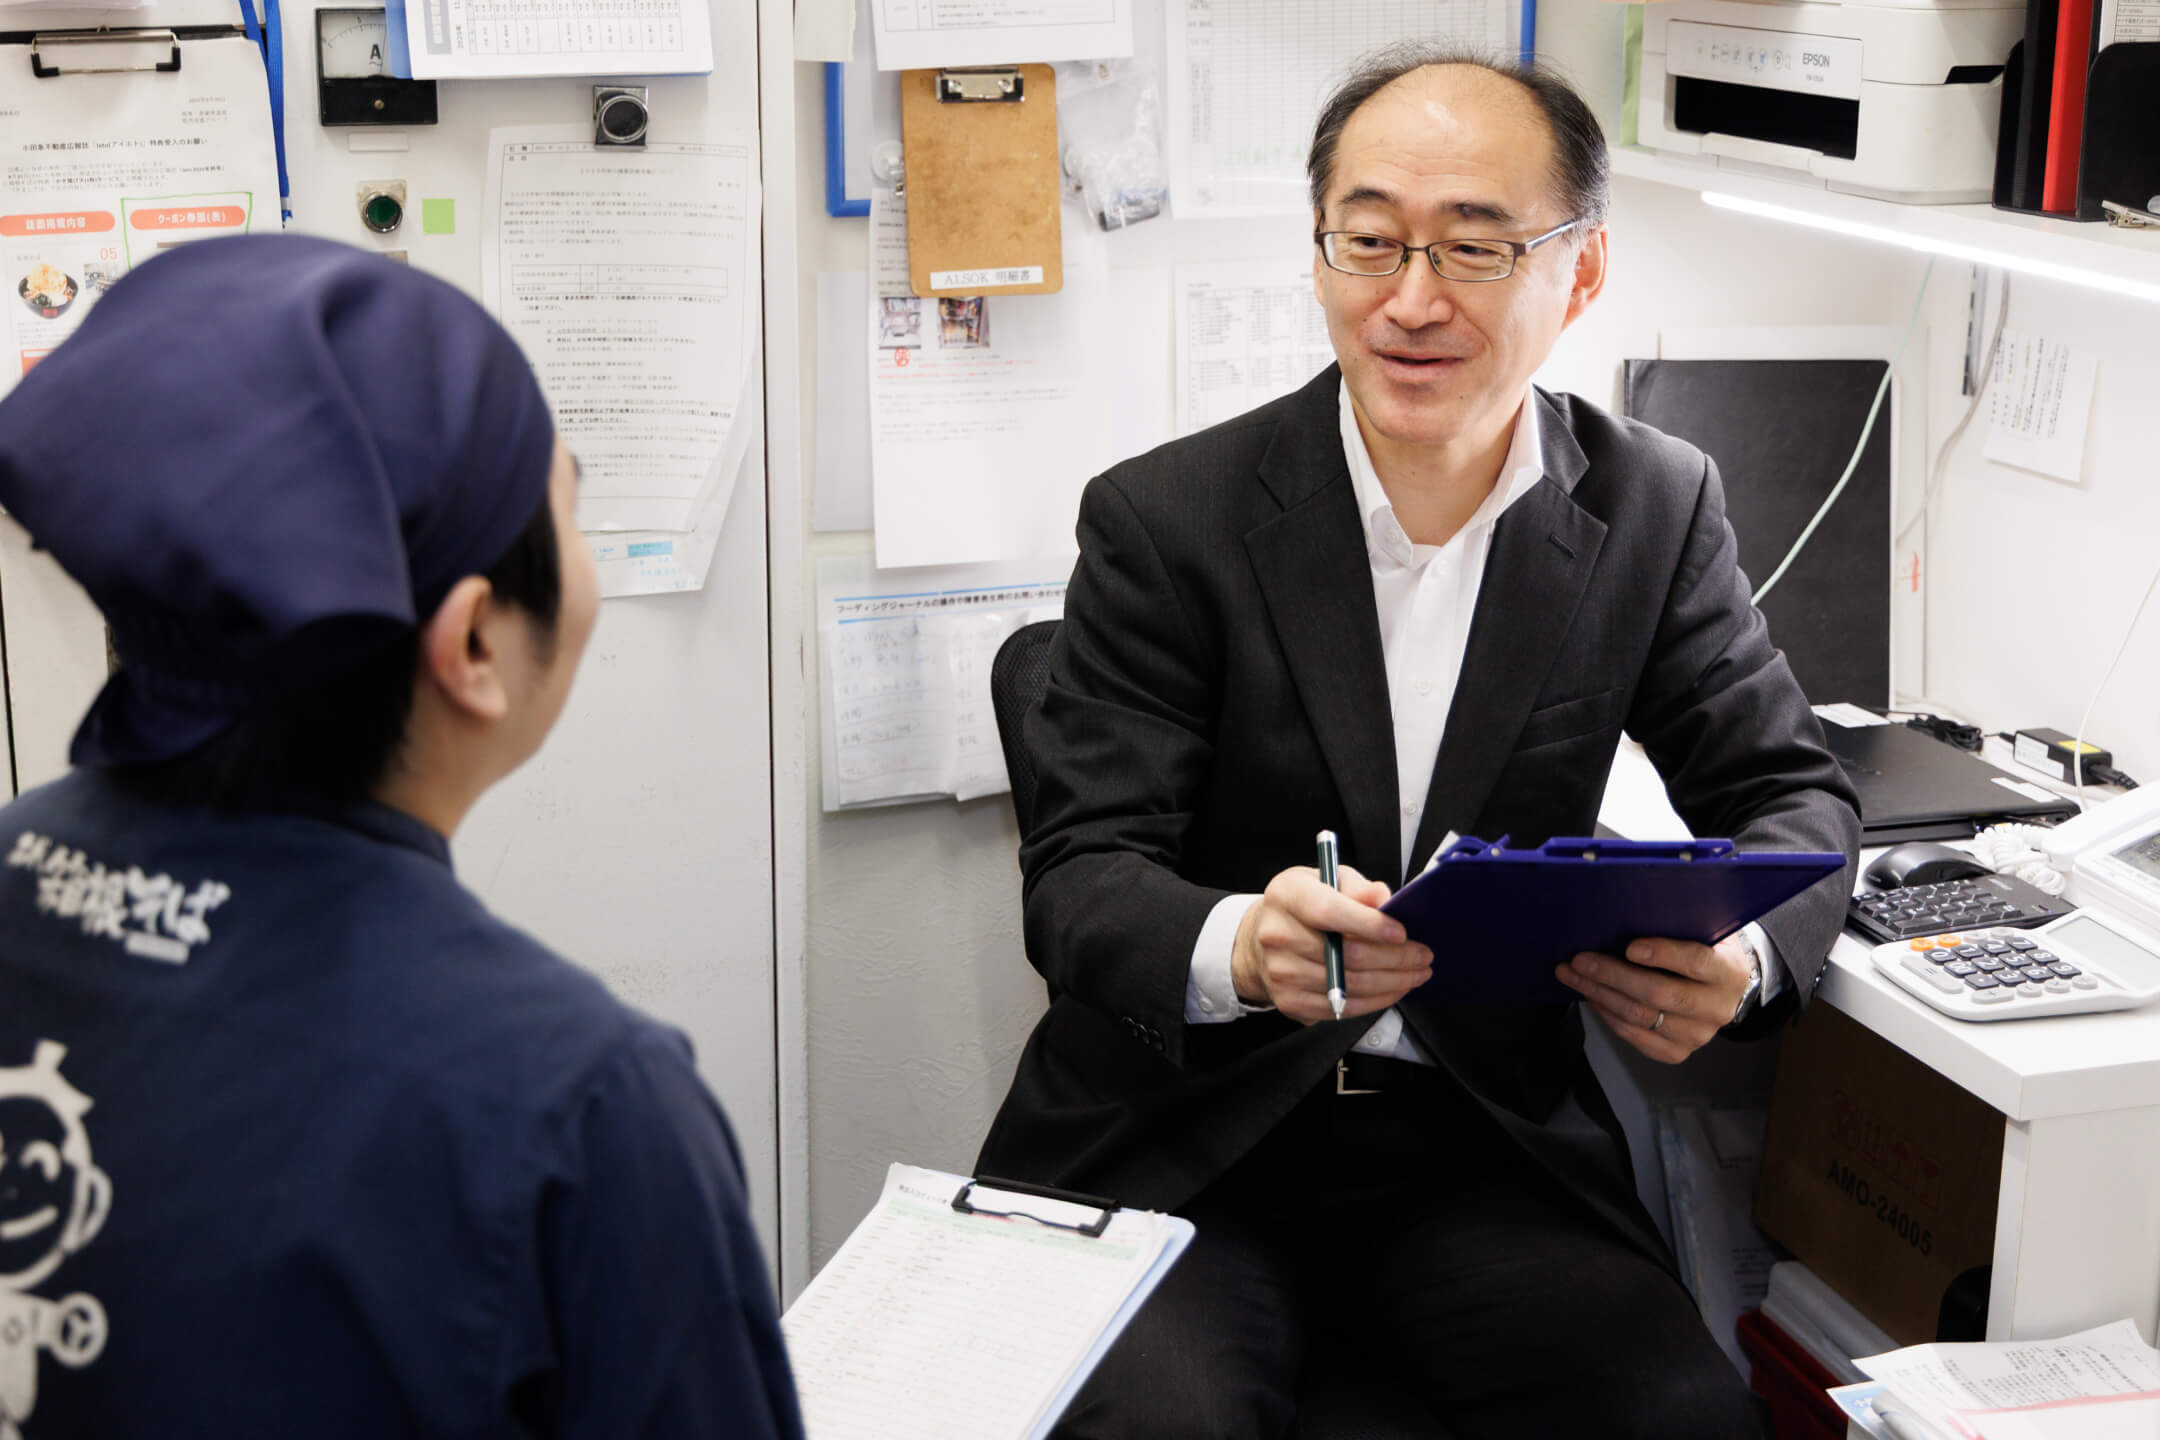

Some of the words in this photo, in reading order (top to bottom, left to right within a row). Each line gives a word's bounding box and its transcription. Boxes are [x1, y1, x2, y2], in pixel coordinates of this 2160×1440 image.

[370, 43, 381, 60] A
[1802, 52, 1830, 68] EPSON
[100, 247, 118, 261] 05
[1825, 1159, 1932, 1256] AMO-24005
